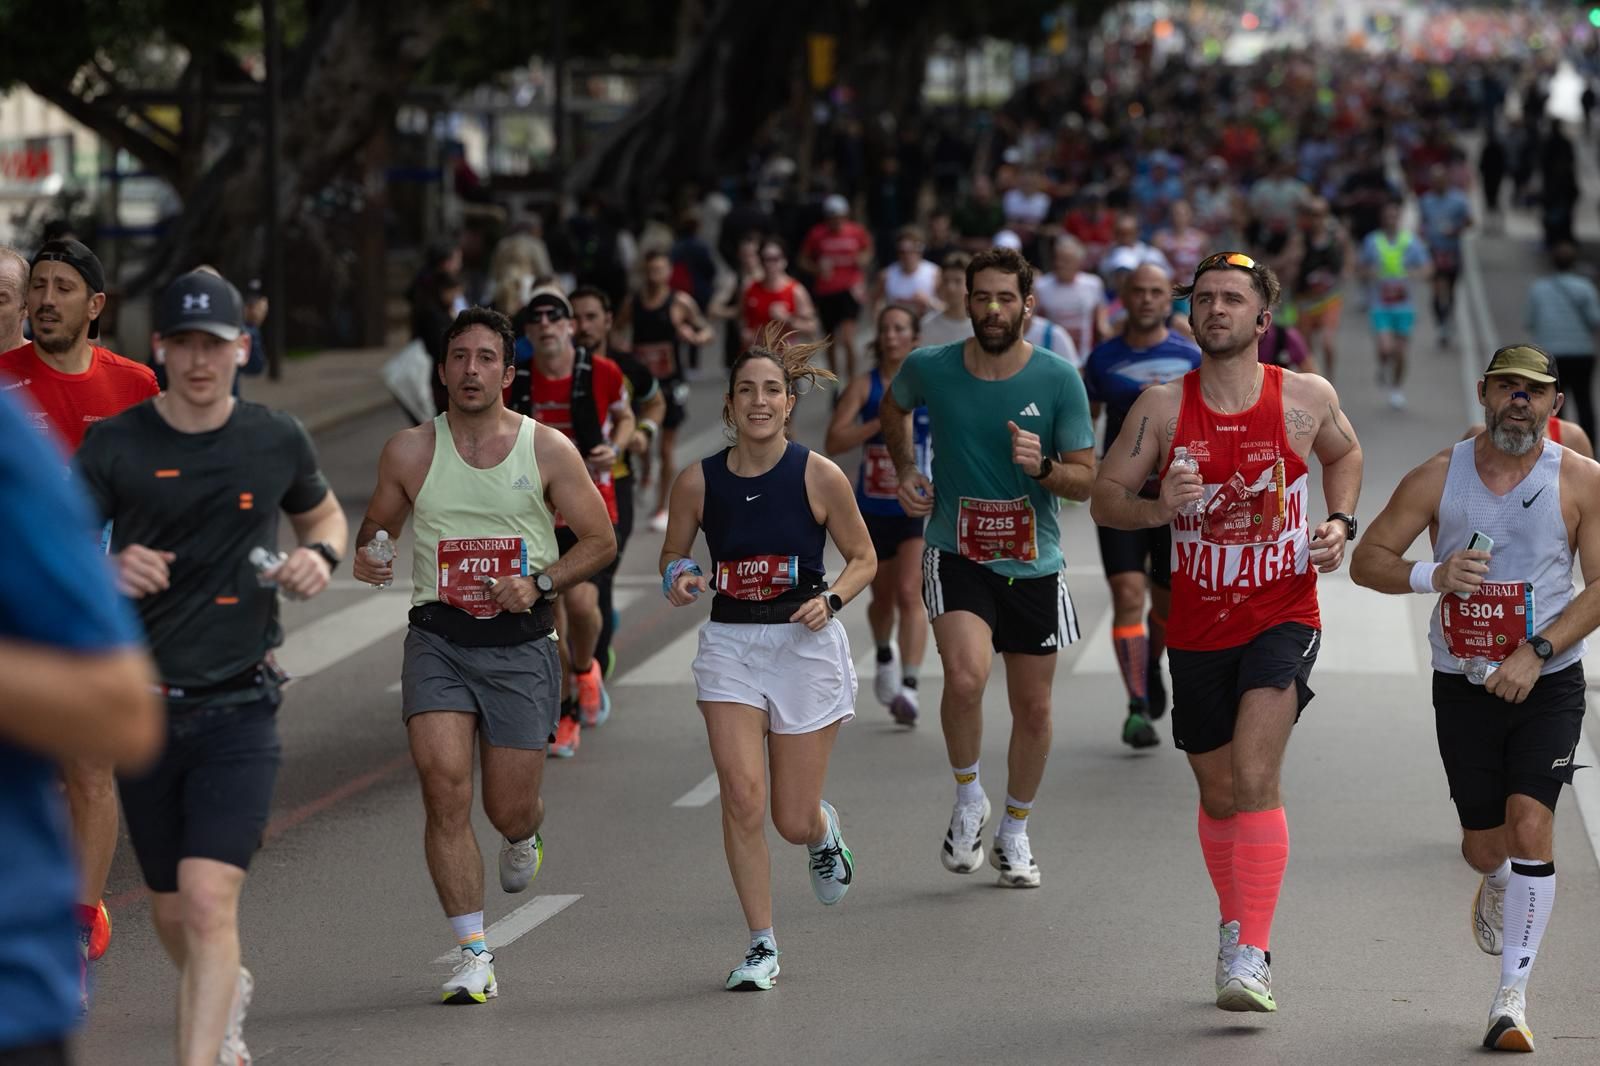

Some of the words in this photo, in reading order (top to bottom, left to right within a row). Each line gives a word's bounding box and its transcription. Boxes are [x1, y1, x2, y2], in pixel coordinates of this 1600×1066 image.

[979, 502, 1024, 512] GENERALI
[977, 516, 1015, 530] 7255
[460, 540, 515, 551] GENERALI
[459, 558, 499, 572] 4701
[737, 561, 769, 576] 4700
[1474, 584, 1519, 597] NERALI
[1460, 603, 1504, 619] 5304
